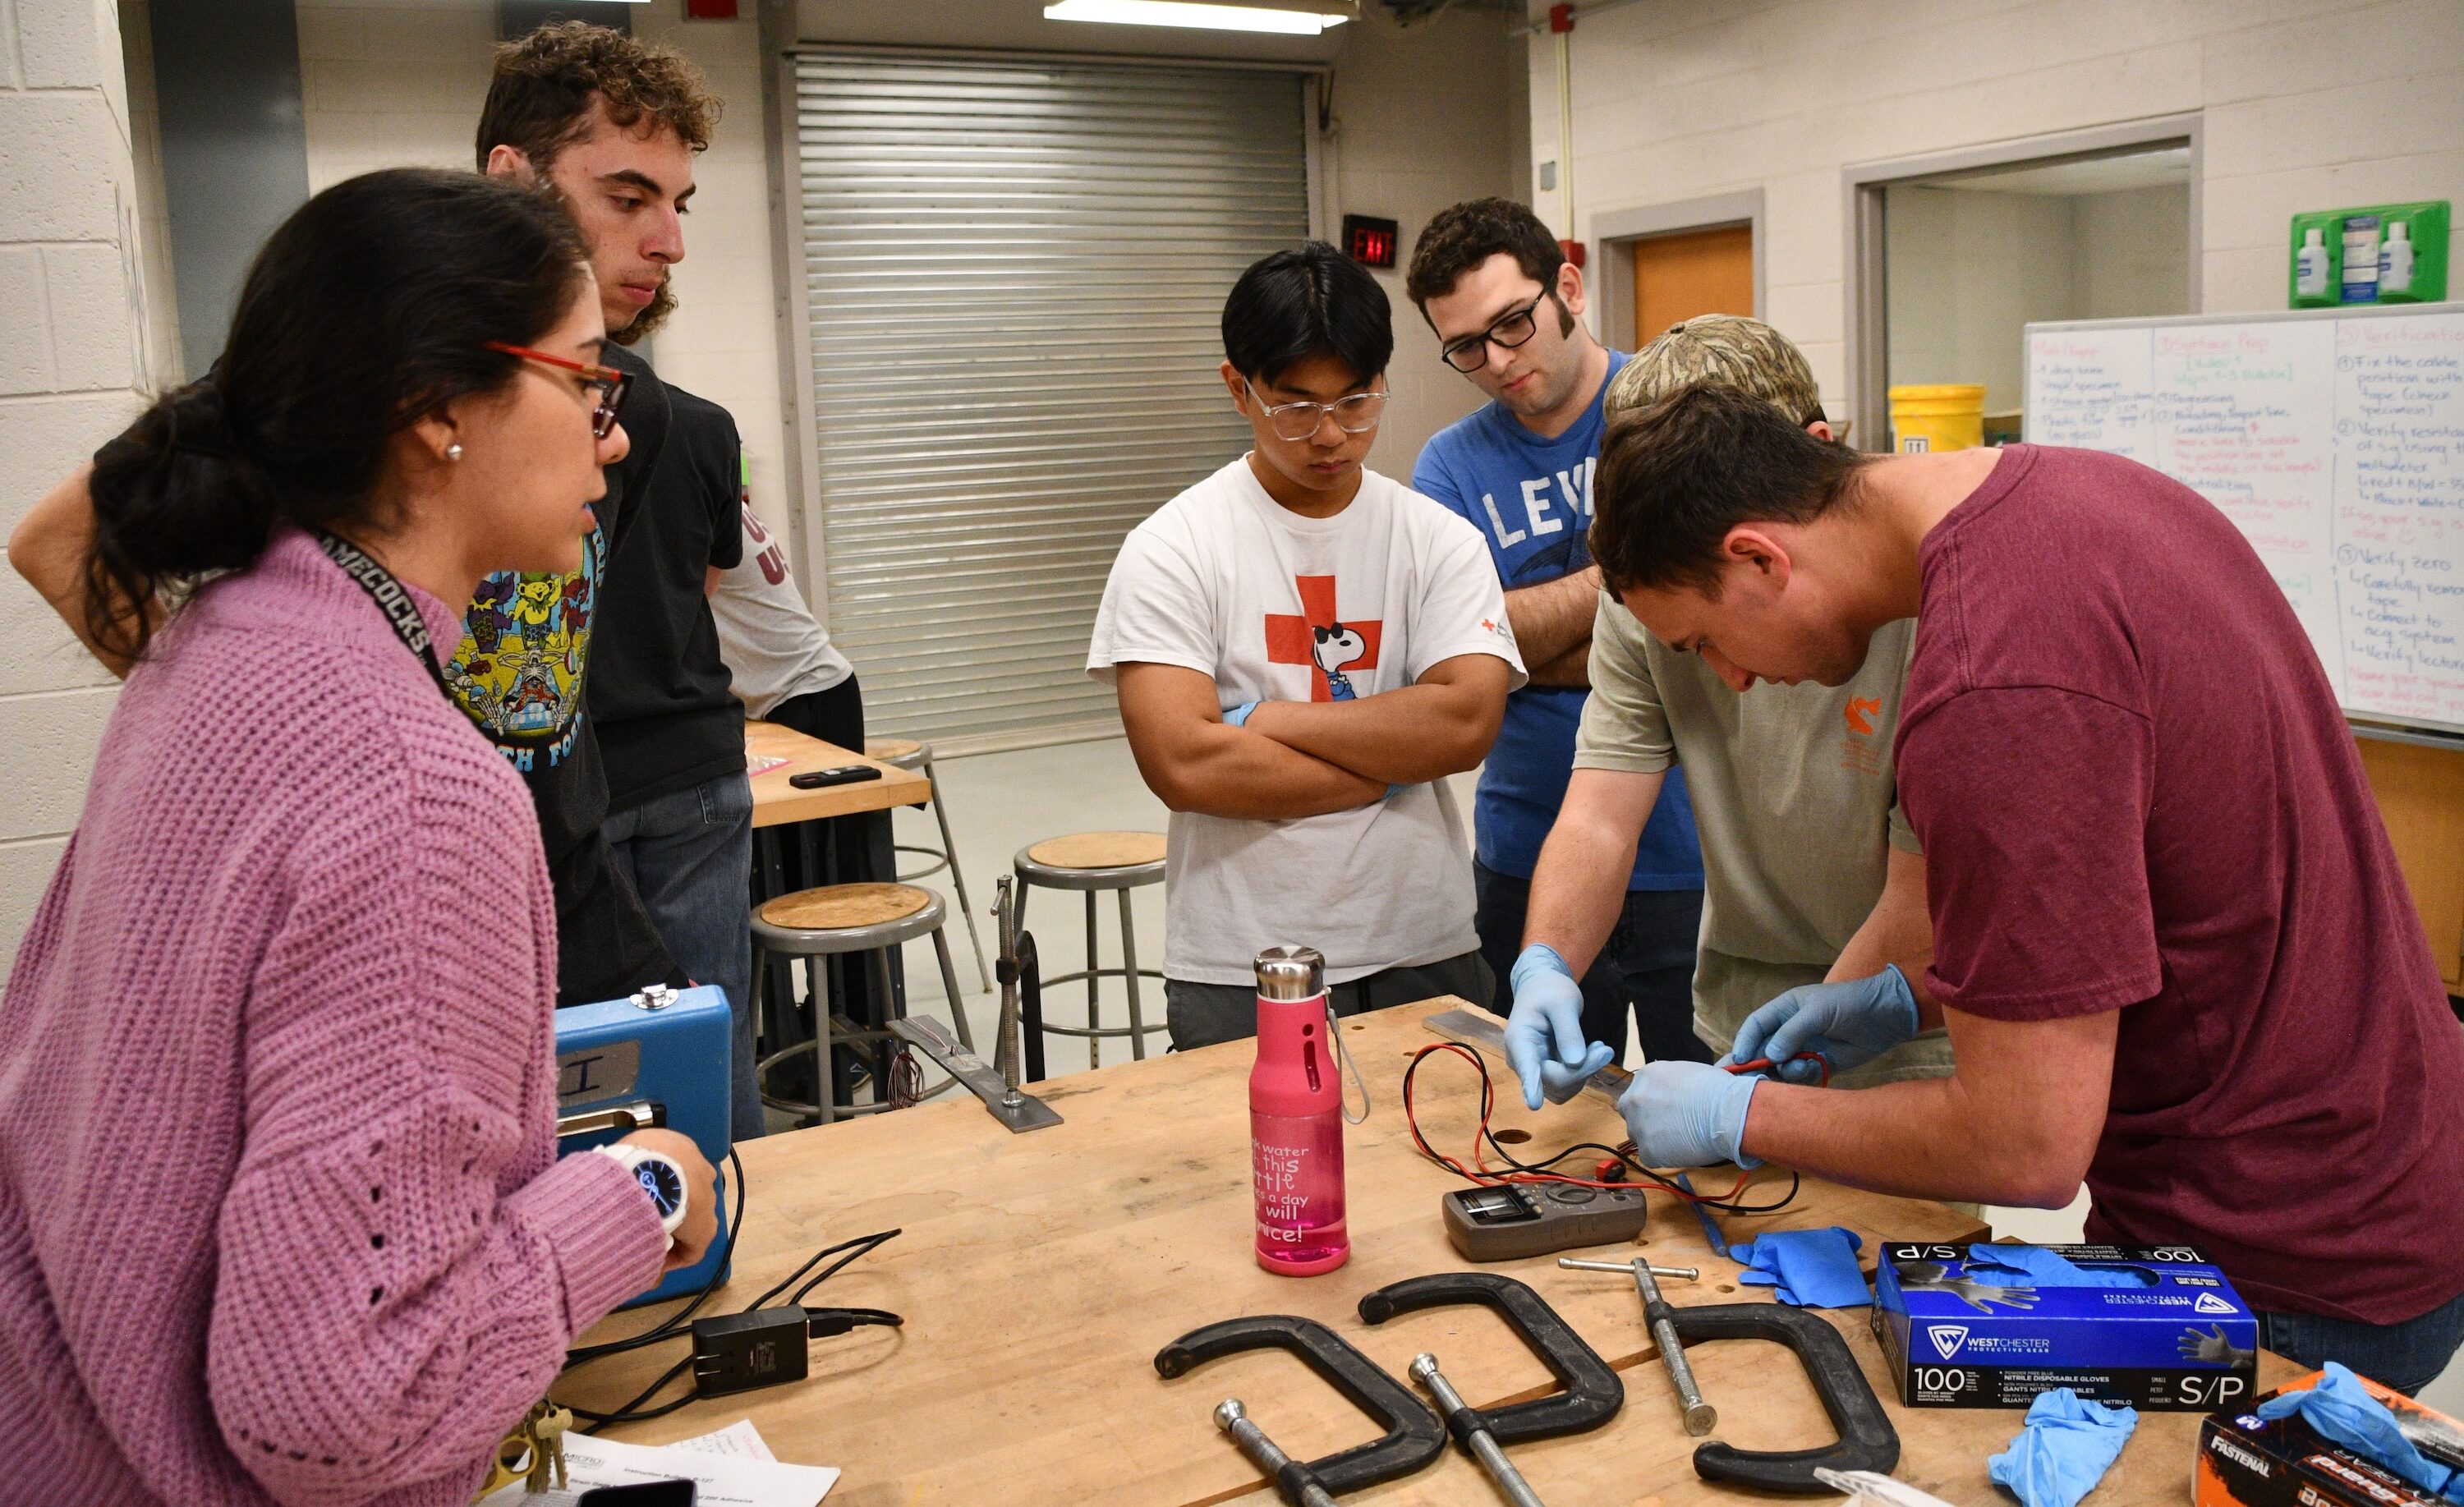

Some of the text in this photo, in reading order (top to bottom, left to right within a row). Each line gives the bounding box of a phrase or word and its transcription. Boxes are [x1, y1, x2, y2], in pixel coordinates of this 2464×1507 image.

[1354, 227, 1395, 264] EXIT
[2386, 355, 2412, 368] the
[2357, 374, 2418, 391] position
[2358, 421, 2407, 443] Verify
[2359, 549, 2406, 575] Verify
[2412, 555, 2452, 572] zero
[321, 536, 430, 654] AMECOCKS
[2425, 613, 2442, 628] to
[2365, 645, 2413, 673] Verify
[1262, 1144, 1309, 1157] water
[1263, 1154, 1299, 1173] this
[1253, 1169, 1295, 1192] ttle
[1269, 1193, 1276, 1203] a
[1281, 1193, 1309, 1208] day
[1266, 1205, 1298, 1220] will
[2153, 1251, 2205, 1263] 100
[1967, 1337, 2050, 1348] WESTCHESTER
[1914, 1367, 1965, 1392] 100
[2178, 1376, 2245, 1405] S/P
[2210, 1435, 2270, 1478] FASTENAL
